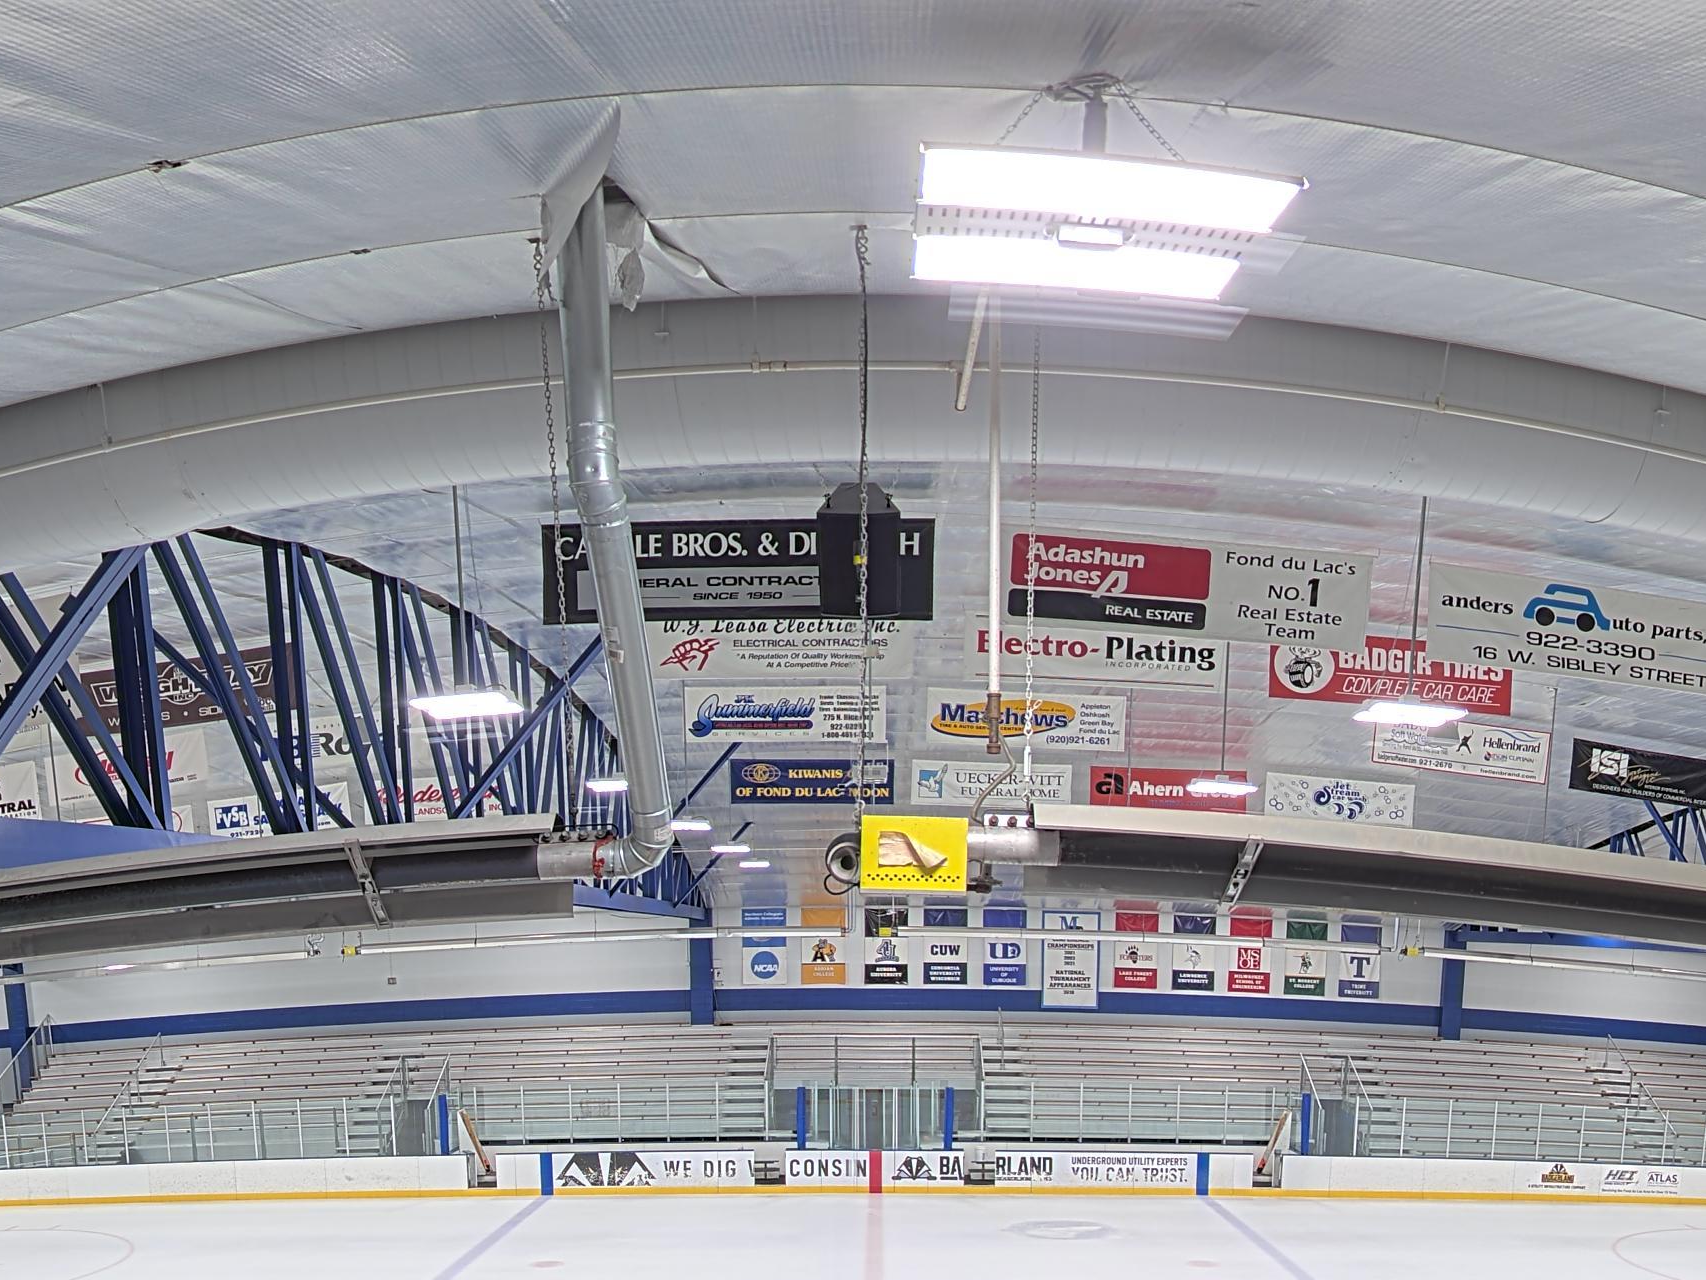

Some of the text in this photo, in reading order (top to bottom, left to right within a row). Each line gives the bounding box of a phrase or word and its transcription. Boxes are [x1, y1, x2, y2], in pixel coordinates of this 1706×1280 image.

[559, 533, 662, 561] CALE
[672, 532, 748, 557] BROS.
[758, 532, 779, 556] &
[1029, 541, 1145, 569] Adashun
[1225, 551, 1357, 576] Fond du Lac's
[1024, 561, 1102, 585] Jones
[693, 591, 783, 600] SINCE 1950
[1441, 594, 1514, 615] anders
[1105, 604, 1194, 623] REAL ESTATE
[1237, 604, 1343, 627] Real Estate
[1264, 623, 1315, 641] Team
[733, 639, 798, 648] ELECTRICAL
[1525, 631, 1656, 661] 922-3390
[1105, 636, 1216, 672] Plating
[1472, 645, 1497, 660] 16
[1507, 649, 1536, 665] W.
[1546, 655, 1621, 676] SIBLEY
[1105, 661, 1191, 671] INCORPORATED
[1343, 676, 1496, 704] COMPLETE CAR CARE
[689, 693, 816, 738] Summerfield
[940, 702, 1070, 728] Mahews
[1080, 702, 1111, 711] Appleton
[1078, 727, 1096, 735] Fond
[1107, 728, 1120, 736] Lac
[1079, 719, 1115, 728] Green Bay
[1046, 734, 1111, 746] (920)921-6261
[1483, 736, 1541, 754] Hellenbrand
[1419, 758, 1453, 769] 921-2670
[788, 769, 843, 779] KIWANIS
[736, 787, 753, 797] OF
[757, 787, 791, 797] FOND
[795, 787, 813, 797] DU
[817, 787, 840, 797] LAC
[1127, 780, 1184, 797] Ahern
[1332, 781, 1352, 791] Jet
[930, 944, 961, 956] CUW
[754, 964, 778, 973] NCAA
[1349, 955, 1371, 979] T
[663, 1159, 693, 1178] WE
[704, 1159, 736, 1178] DIG
[939, 1155, 1053, 1176] BARLAND
[1071, 1156, 1188, 1167] UNDERGROUND UTILITY EXPERTS
[1647, 1172, 1678, 1184] ATLAS
